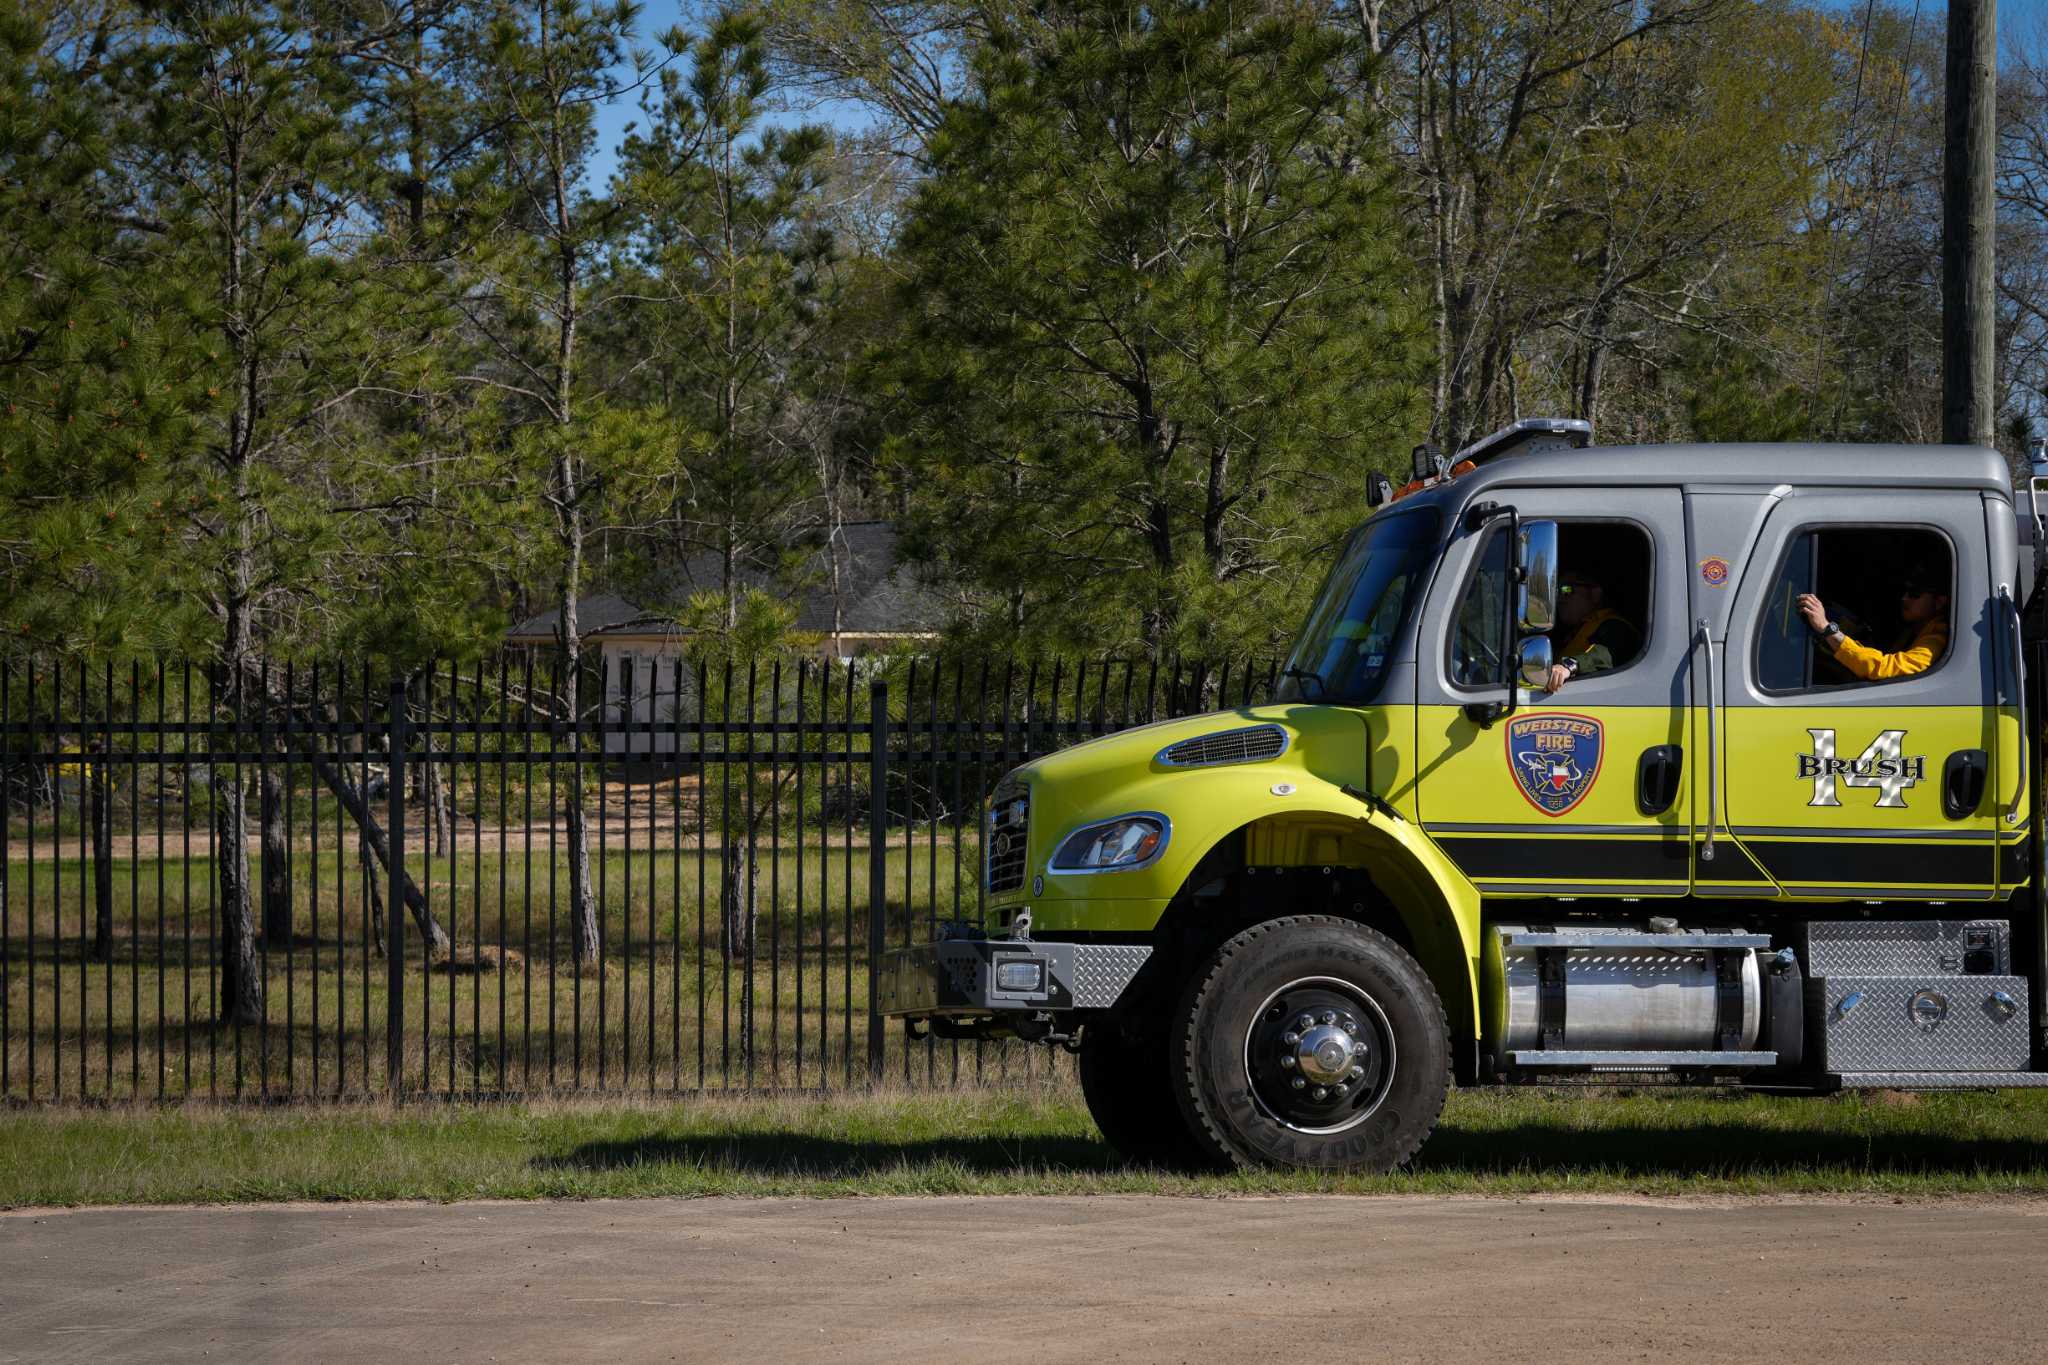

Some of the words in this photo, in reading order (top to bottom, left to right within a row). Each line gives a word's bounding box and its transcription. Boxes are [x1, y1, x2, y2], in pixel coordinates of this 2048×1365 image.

[1513, 720, 1597, 738] WEBSTER
[1536, 734, 1575, 751] FIRE
[1797, 754, 1926, 780] BRUSH
[1806, 728, 1915, 808] 14
